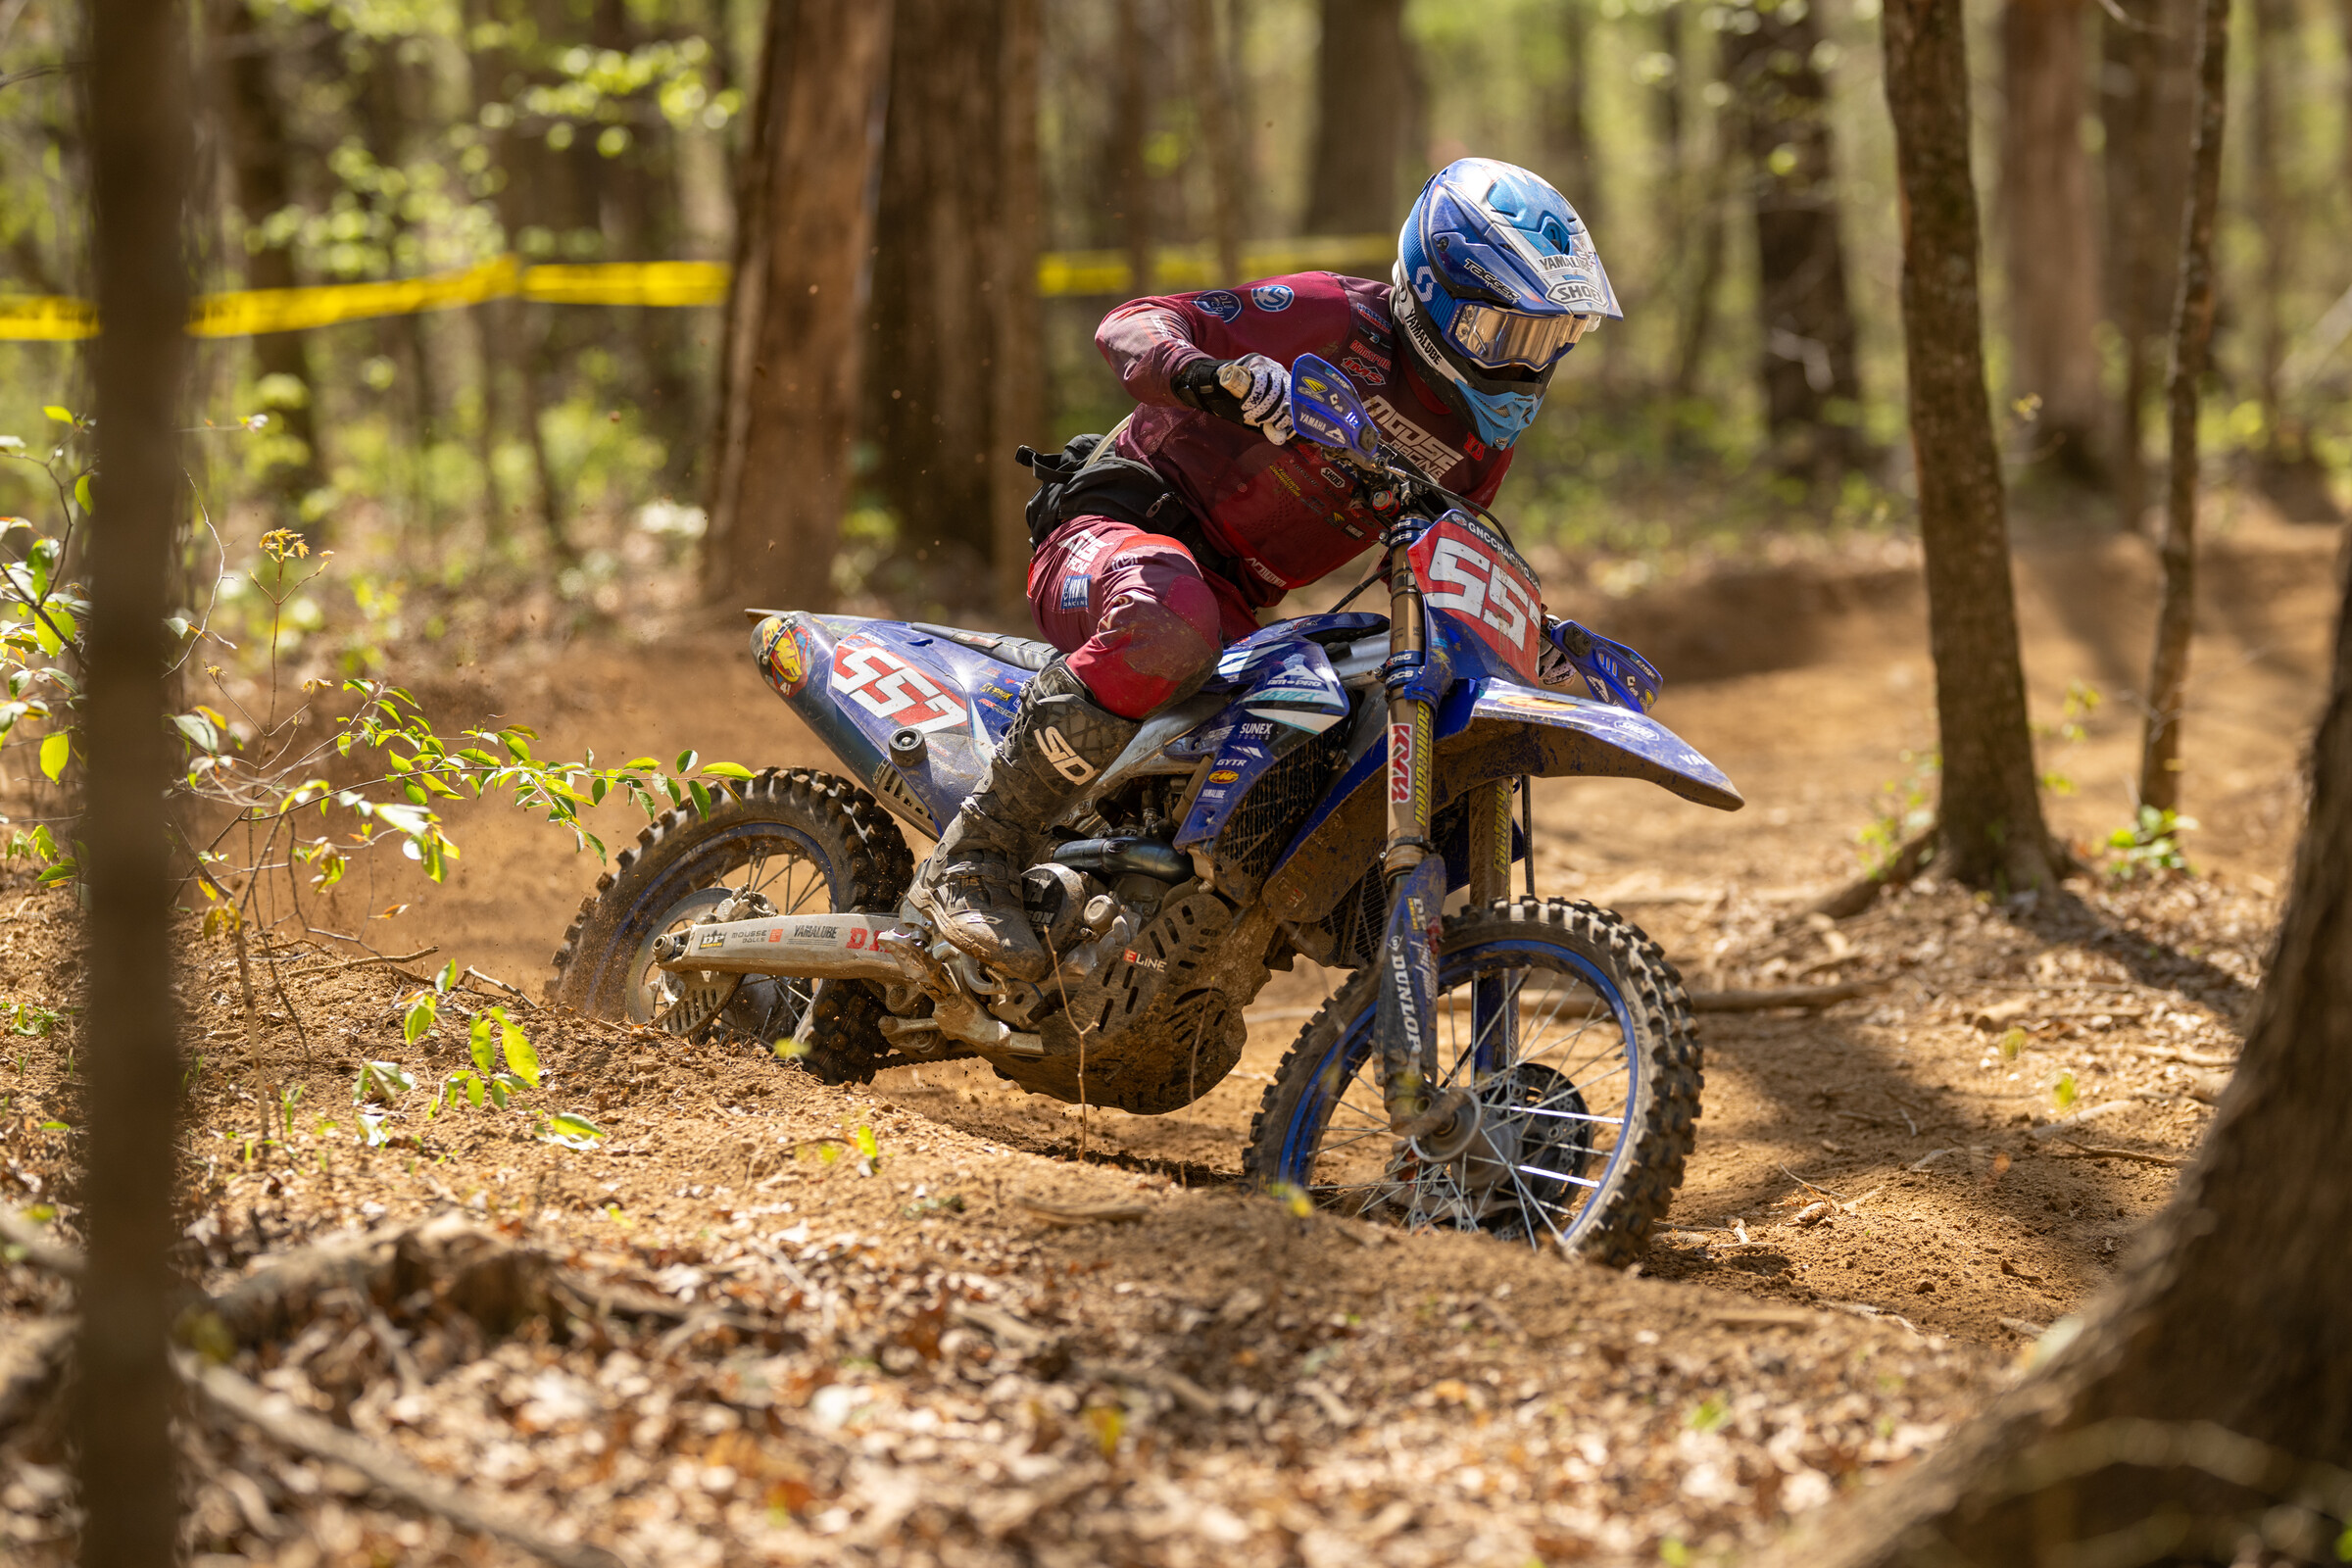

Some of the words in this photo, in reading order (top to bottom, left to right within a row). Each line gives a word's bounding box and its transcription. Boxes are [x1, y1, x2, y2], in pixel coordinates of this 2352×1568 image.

[1539, 255, 1588, 271] YAMALU
[1557, 284, 1601, 304] SHOEI
[1404, 309, 1443, 366] YAMALUBE
[1349, 340, 1392, 371] MOTOSPOR
[1344, 359, 1383, 384] IMS
[1299, 413, 1327, 432] YAMAHA
[1362, 394, 1465, 472] MOOSE
[1389, 438, 1446, 483] RACING
[1322, 468, 1345, 488] SHOEI
[830, 647, 968, 735] 557
[1239, 723, 1273, 735] SUNEX
[1216, 759, 1248, 767] GYTR
[1390, 723, 1413, 804] KYB
[1209, 771, 1240, 782] FMF
[702, 934, 724, 945] DP
[731, 929, 767, 939] MOUSSE
[794, 925, 838, 939] YAMALUBE
[846, 927, 893, 954] D.I.
[1392, 955, 1422, 1053] DUNLOP
